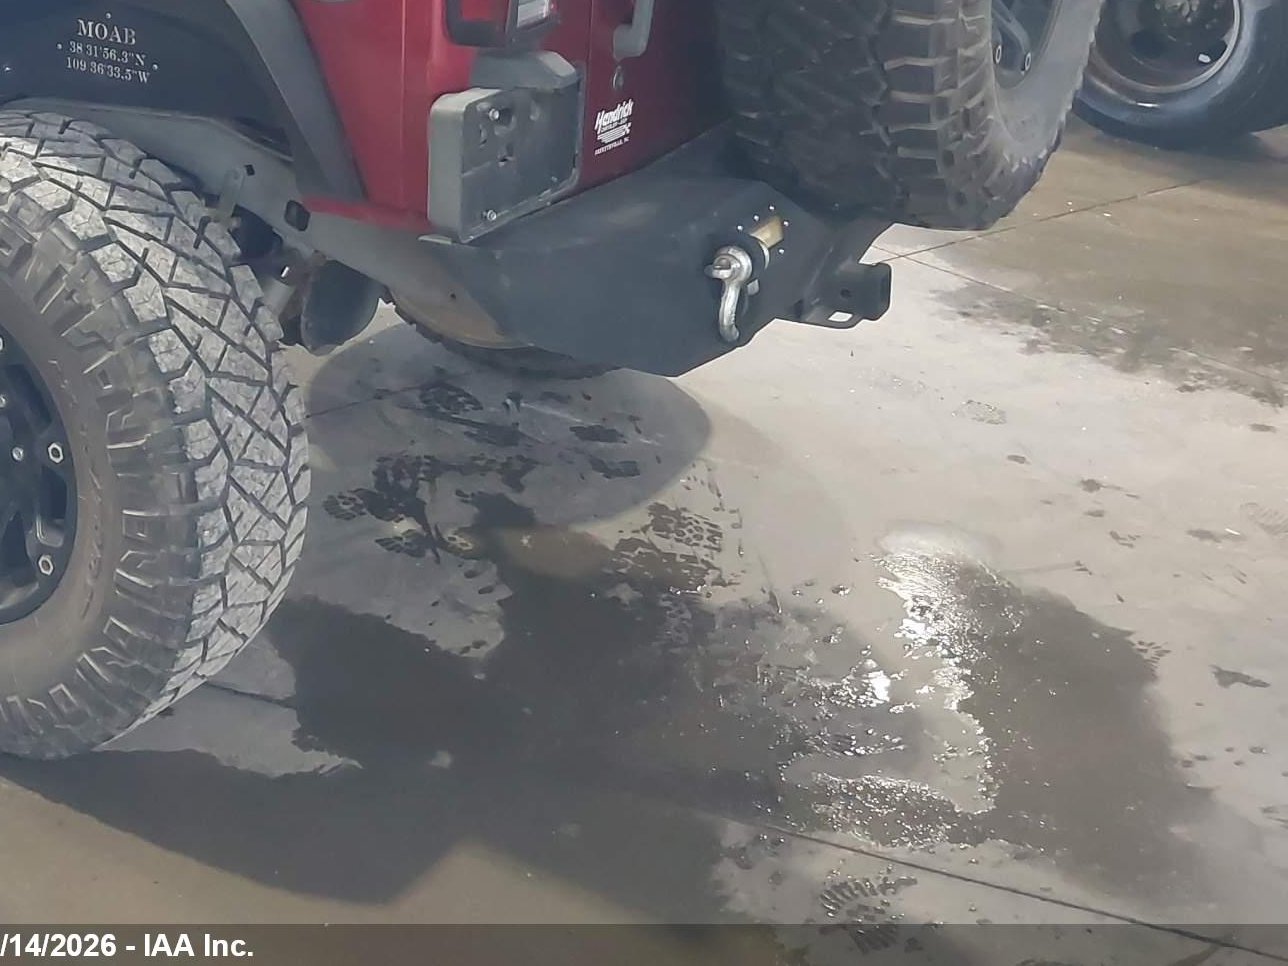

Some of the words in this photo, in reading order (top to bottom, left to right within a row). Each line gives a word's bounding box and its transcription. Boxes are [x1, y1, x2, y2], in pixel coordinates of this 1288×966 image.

[77, 18, 136, 45] MOAB
[69, 41, 83, 54] 38
[66, 56, 87, 71] 109
[594, 99, 634, 134] Hendrick
